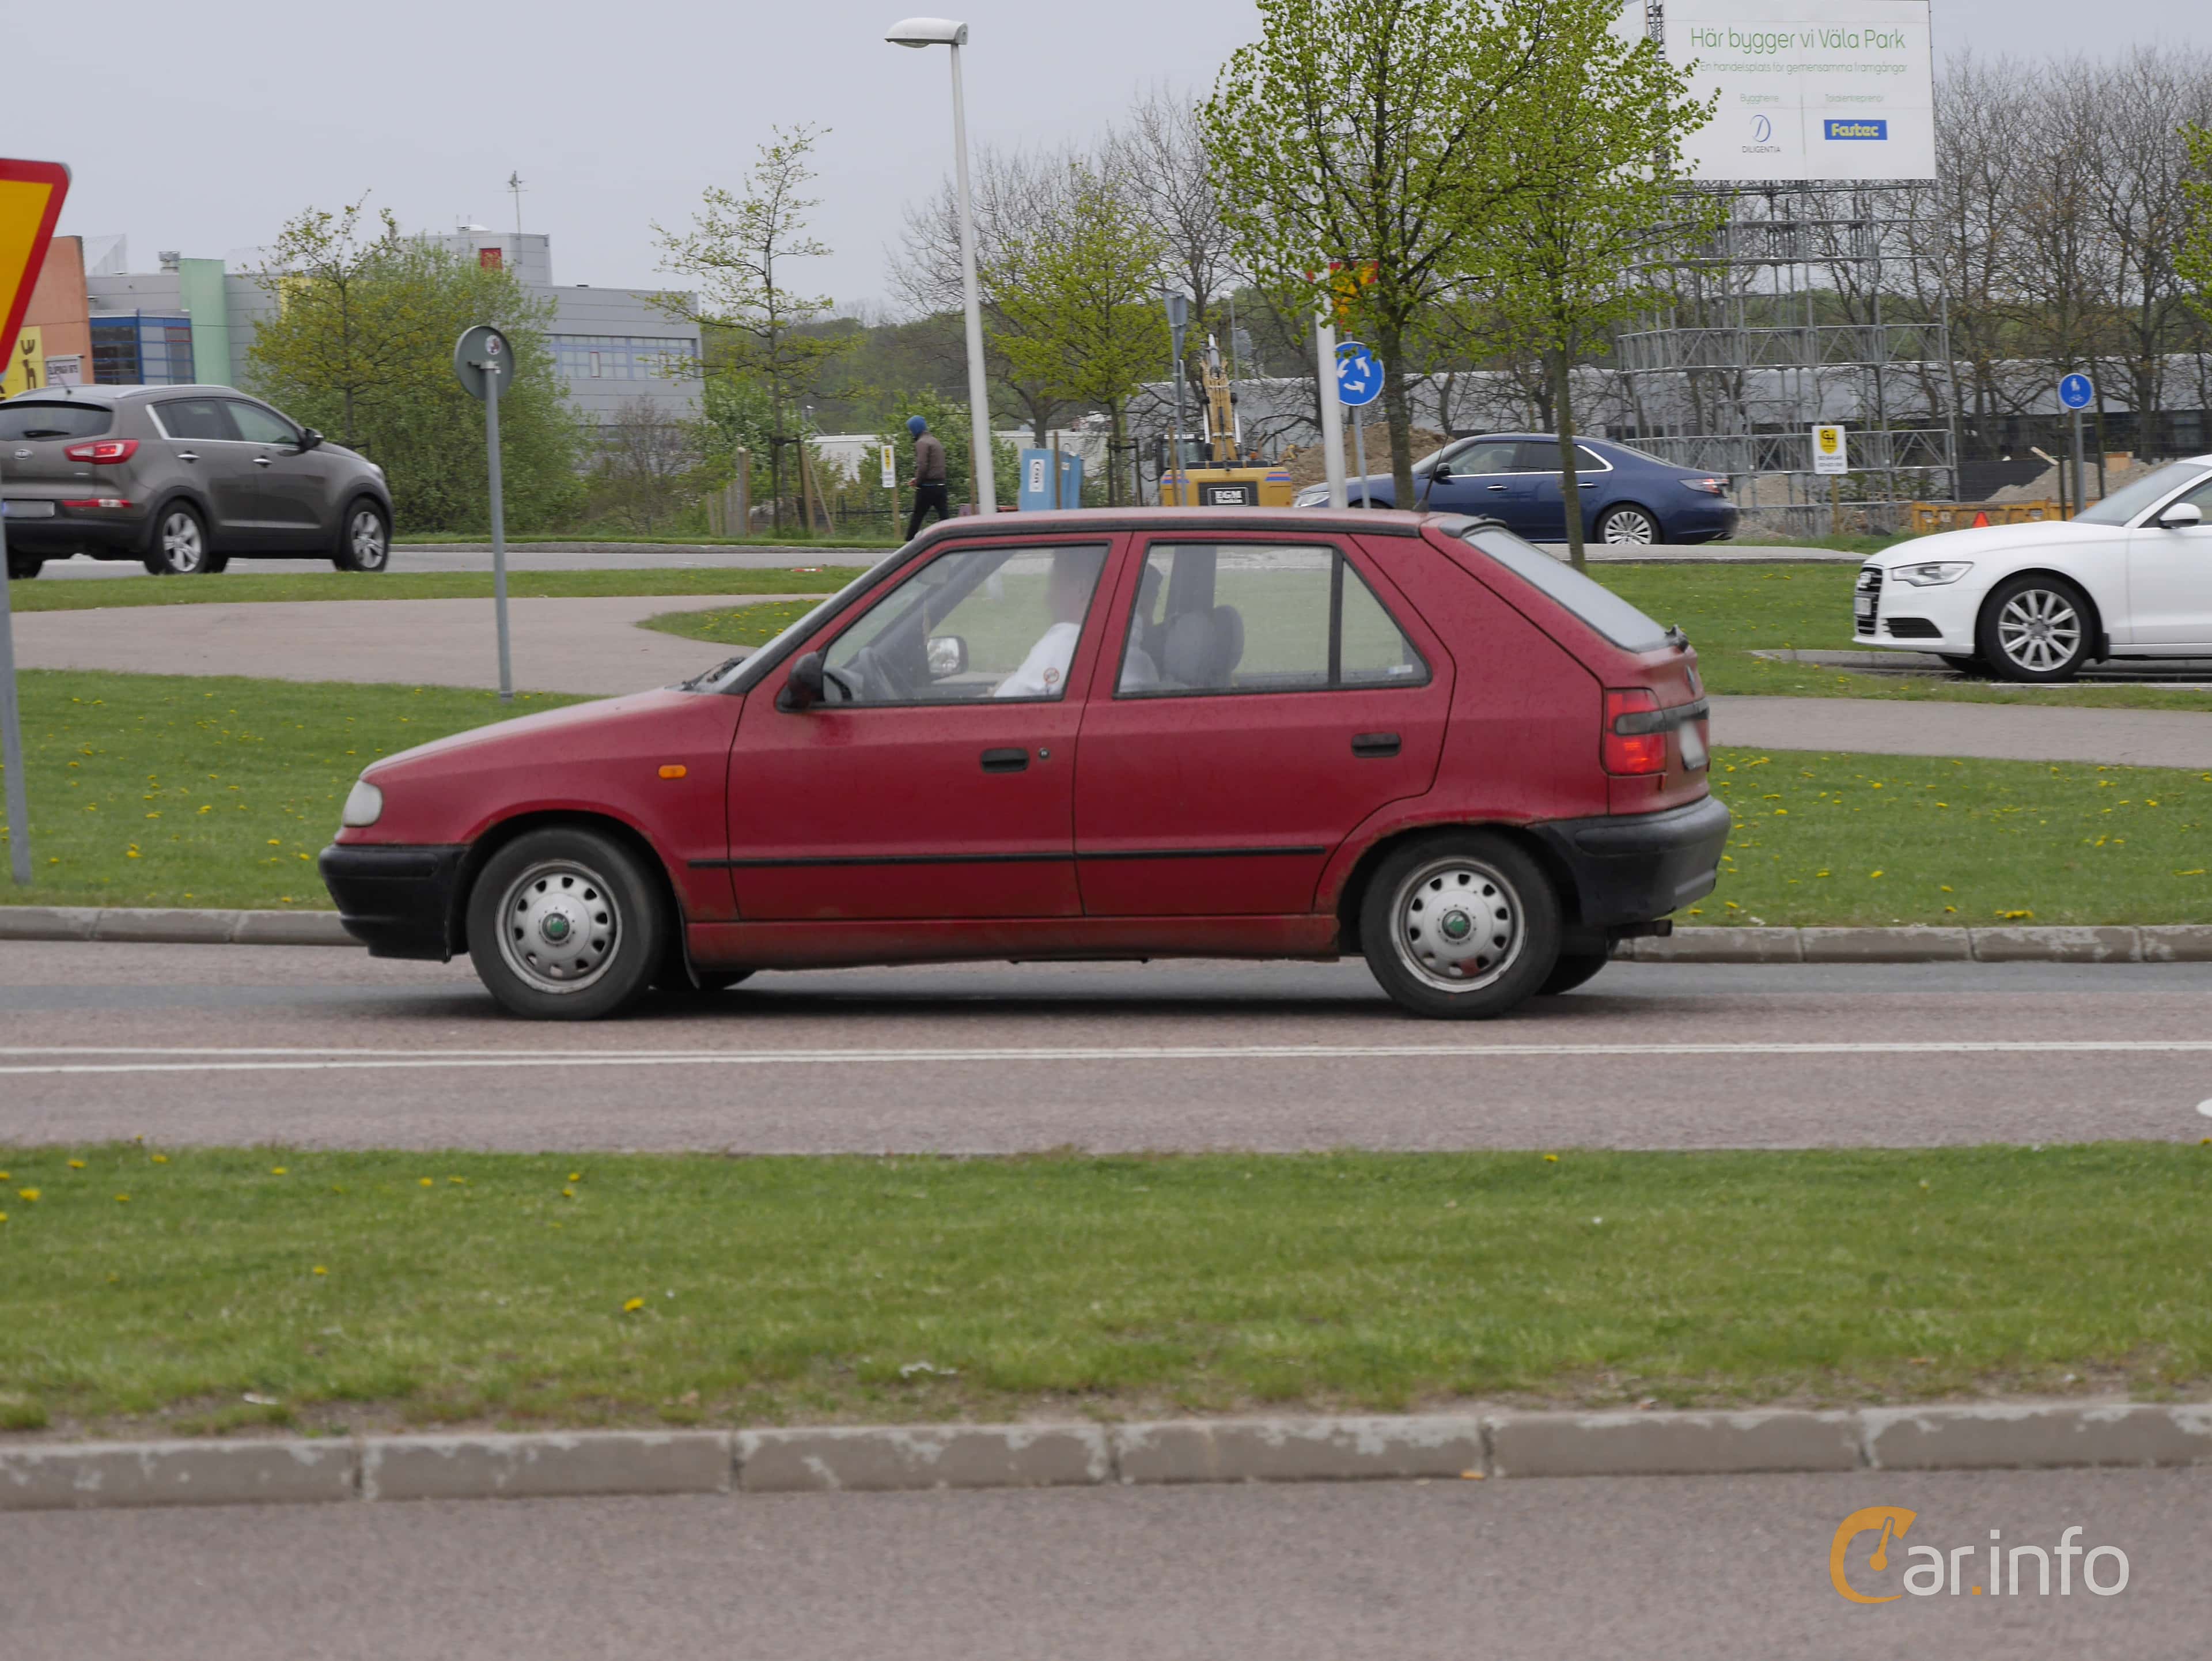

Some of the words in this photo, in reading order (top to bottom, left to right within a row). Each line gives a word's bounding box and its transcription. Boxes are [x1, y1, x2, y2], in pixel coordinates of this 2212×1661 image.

[1691, 28, 1724, 47] Här
[1729, 27, 1796, 54] bygger
[1800, 29, 1814, 48] vi
[1819, 28, 1859, 48] Väla
[1865, 28, 1906, 48] Park
[1700, 61, 1711, 71] En
[1831, 123, 1880, 137] Fastec
